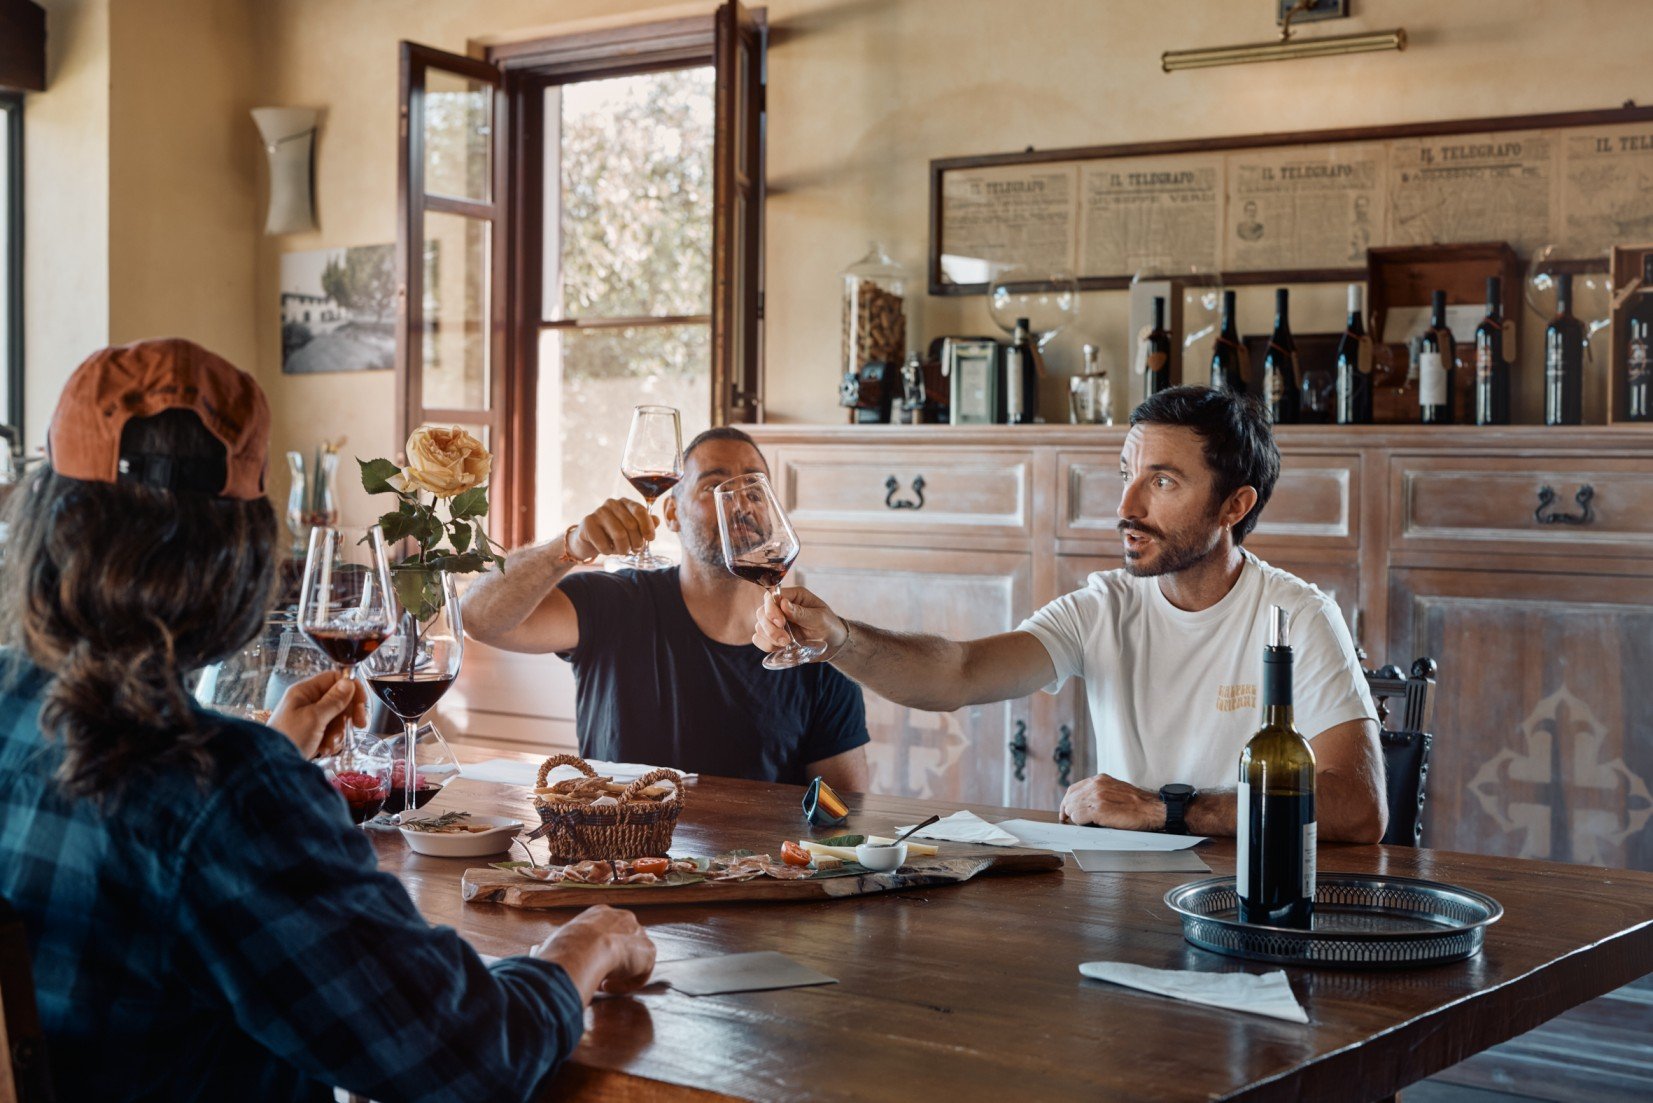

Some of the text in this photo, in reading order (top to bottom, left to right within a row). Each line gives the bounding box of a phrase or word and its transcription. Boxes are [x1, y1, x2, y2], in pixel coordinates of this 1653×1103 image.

[1440, 142, 1523, 161] TELEGRAFO
[1597, 137, 1613, 152] IL
[1109, 173, 1123, 187] IL
[1128, 171, 1195, 186] TELEGRAFO
[1261, 167, 1276, 181] IL
[1280, 164, 1354, 180] TELEGRAFO
[985, 180, 1047, 195] TELEGRAFO
